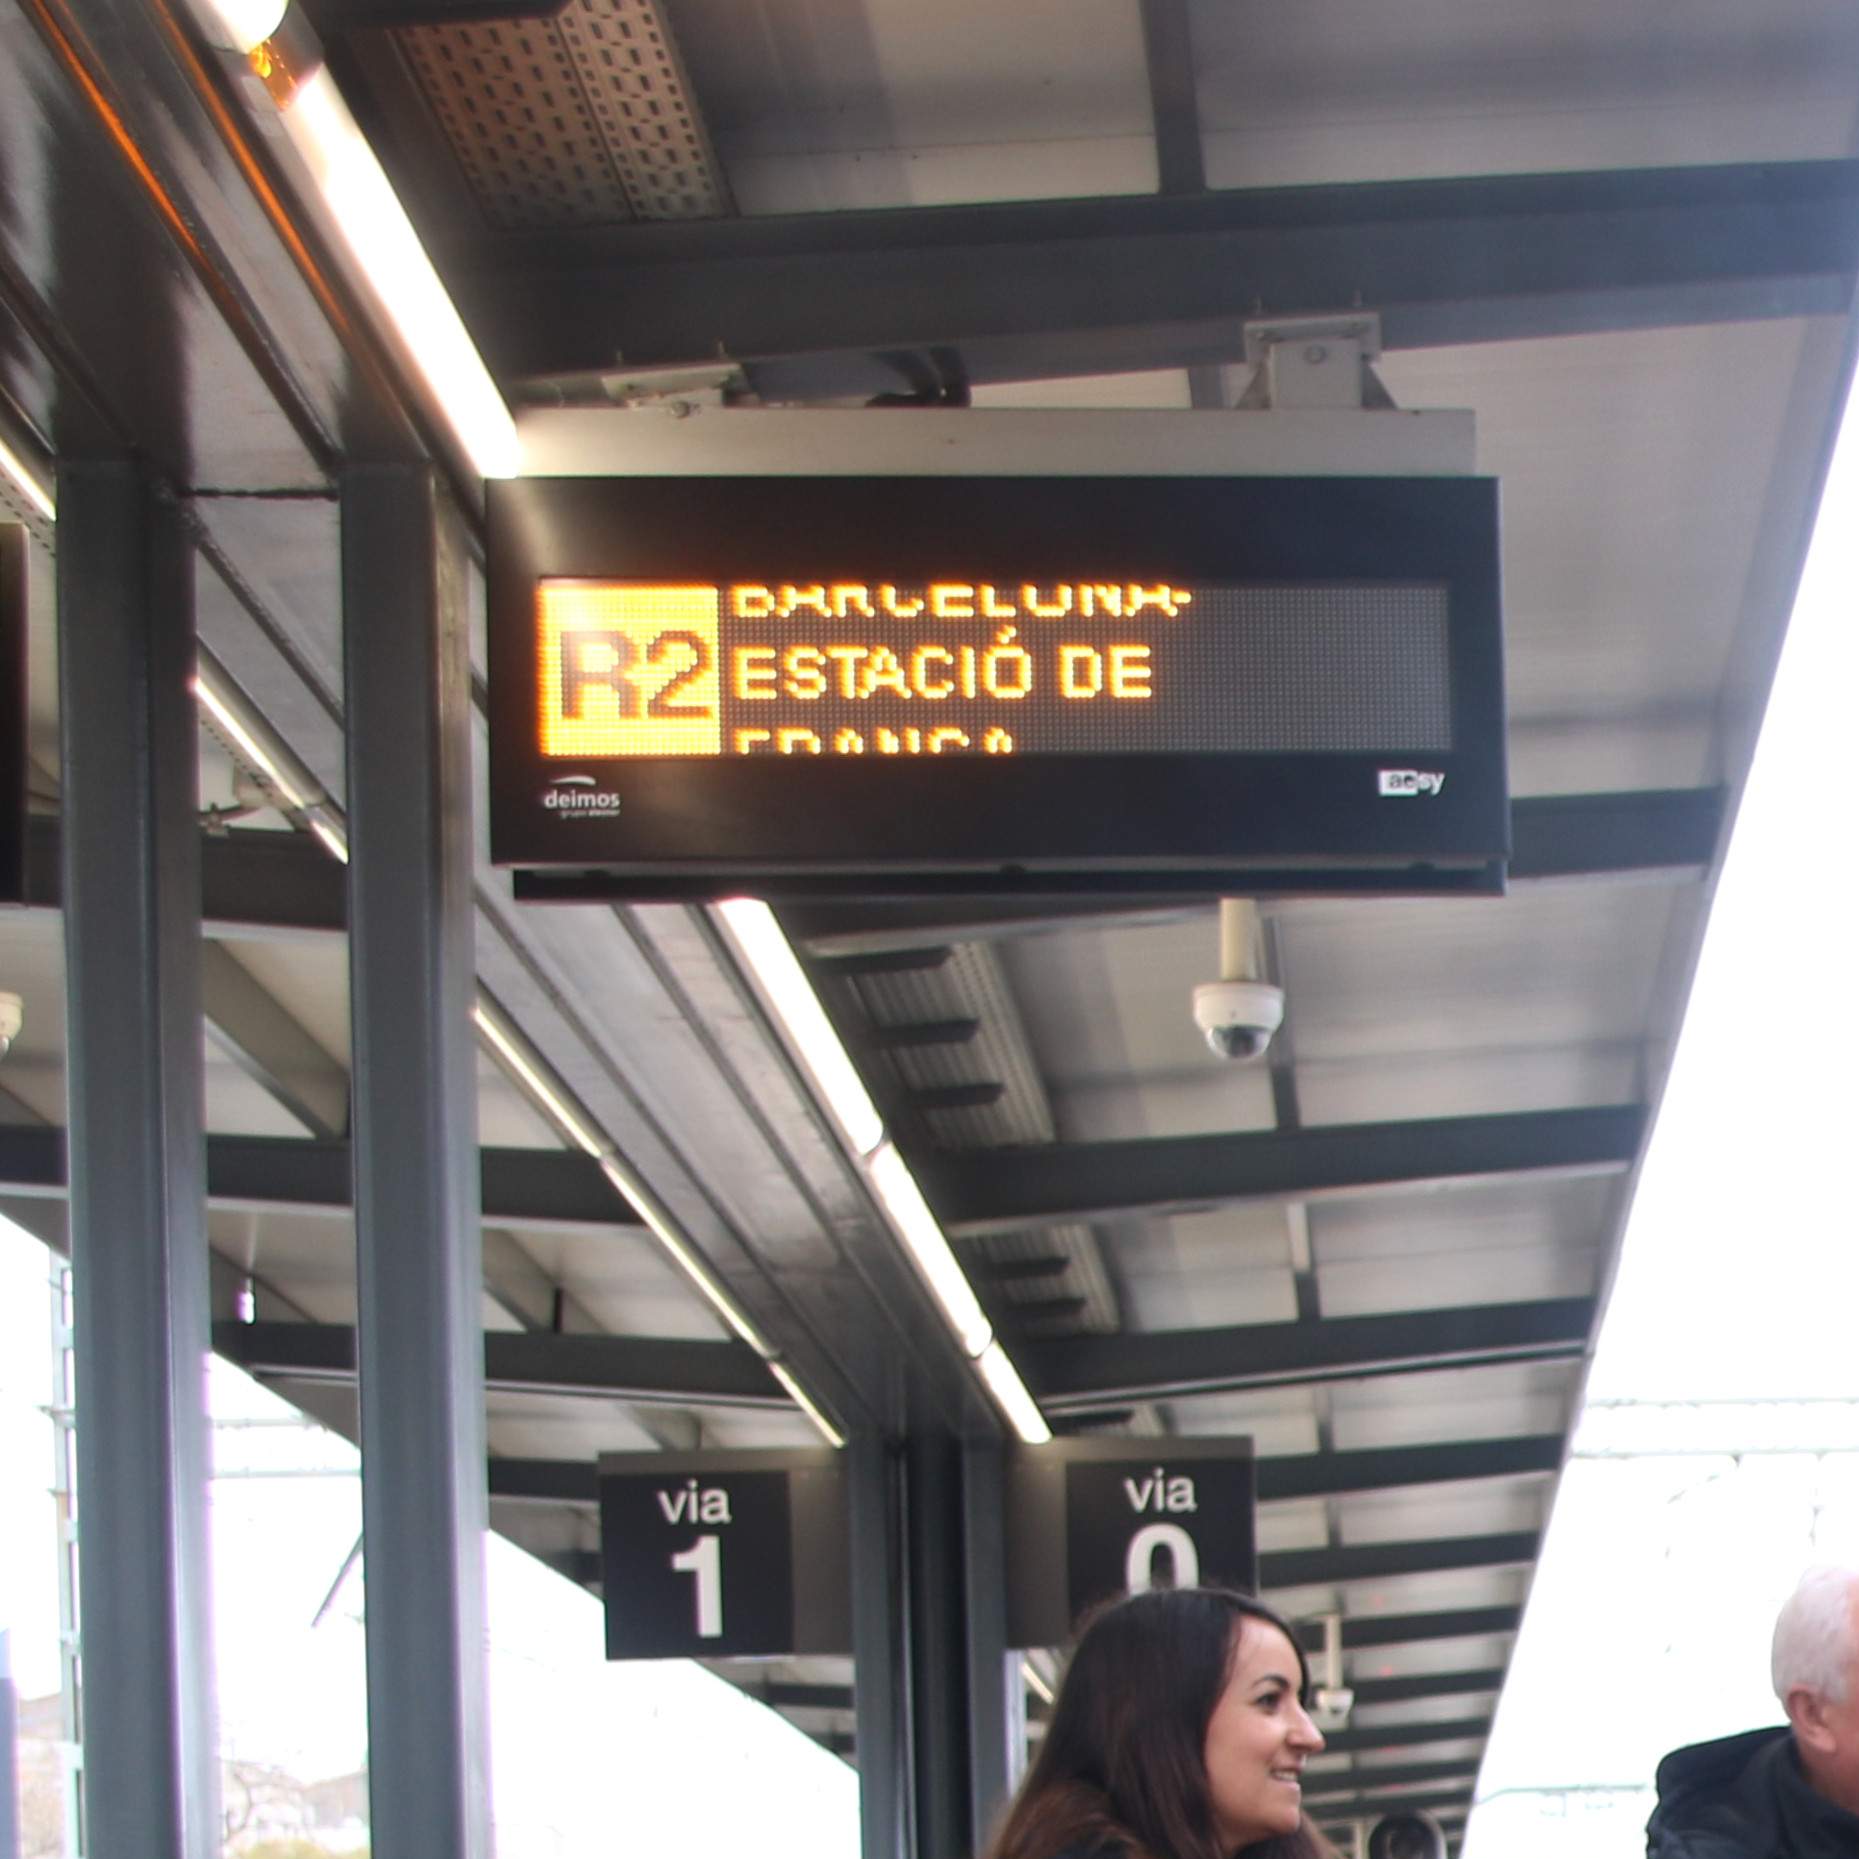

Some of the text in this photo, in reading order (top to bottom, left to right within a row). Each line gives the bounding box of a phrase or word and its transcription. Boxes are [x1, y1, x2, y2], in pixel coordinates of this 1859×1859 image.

[560, 630, 712, 720] R2
[732, 625, 1153, 700] ESTACIÓ DE
[543, 788, 620, 809] deimos
[657, 1479, 732, 1526] via
[1123, 1467, 1198, 1513] via
[671, 1534, 723, 1638] 1
